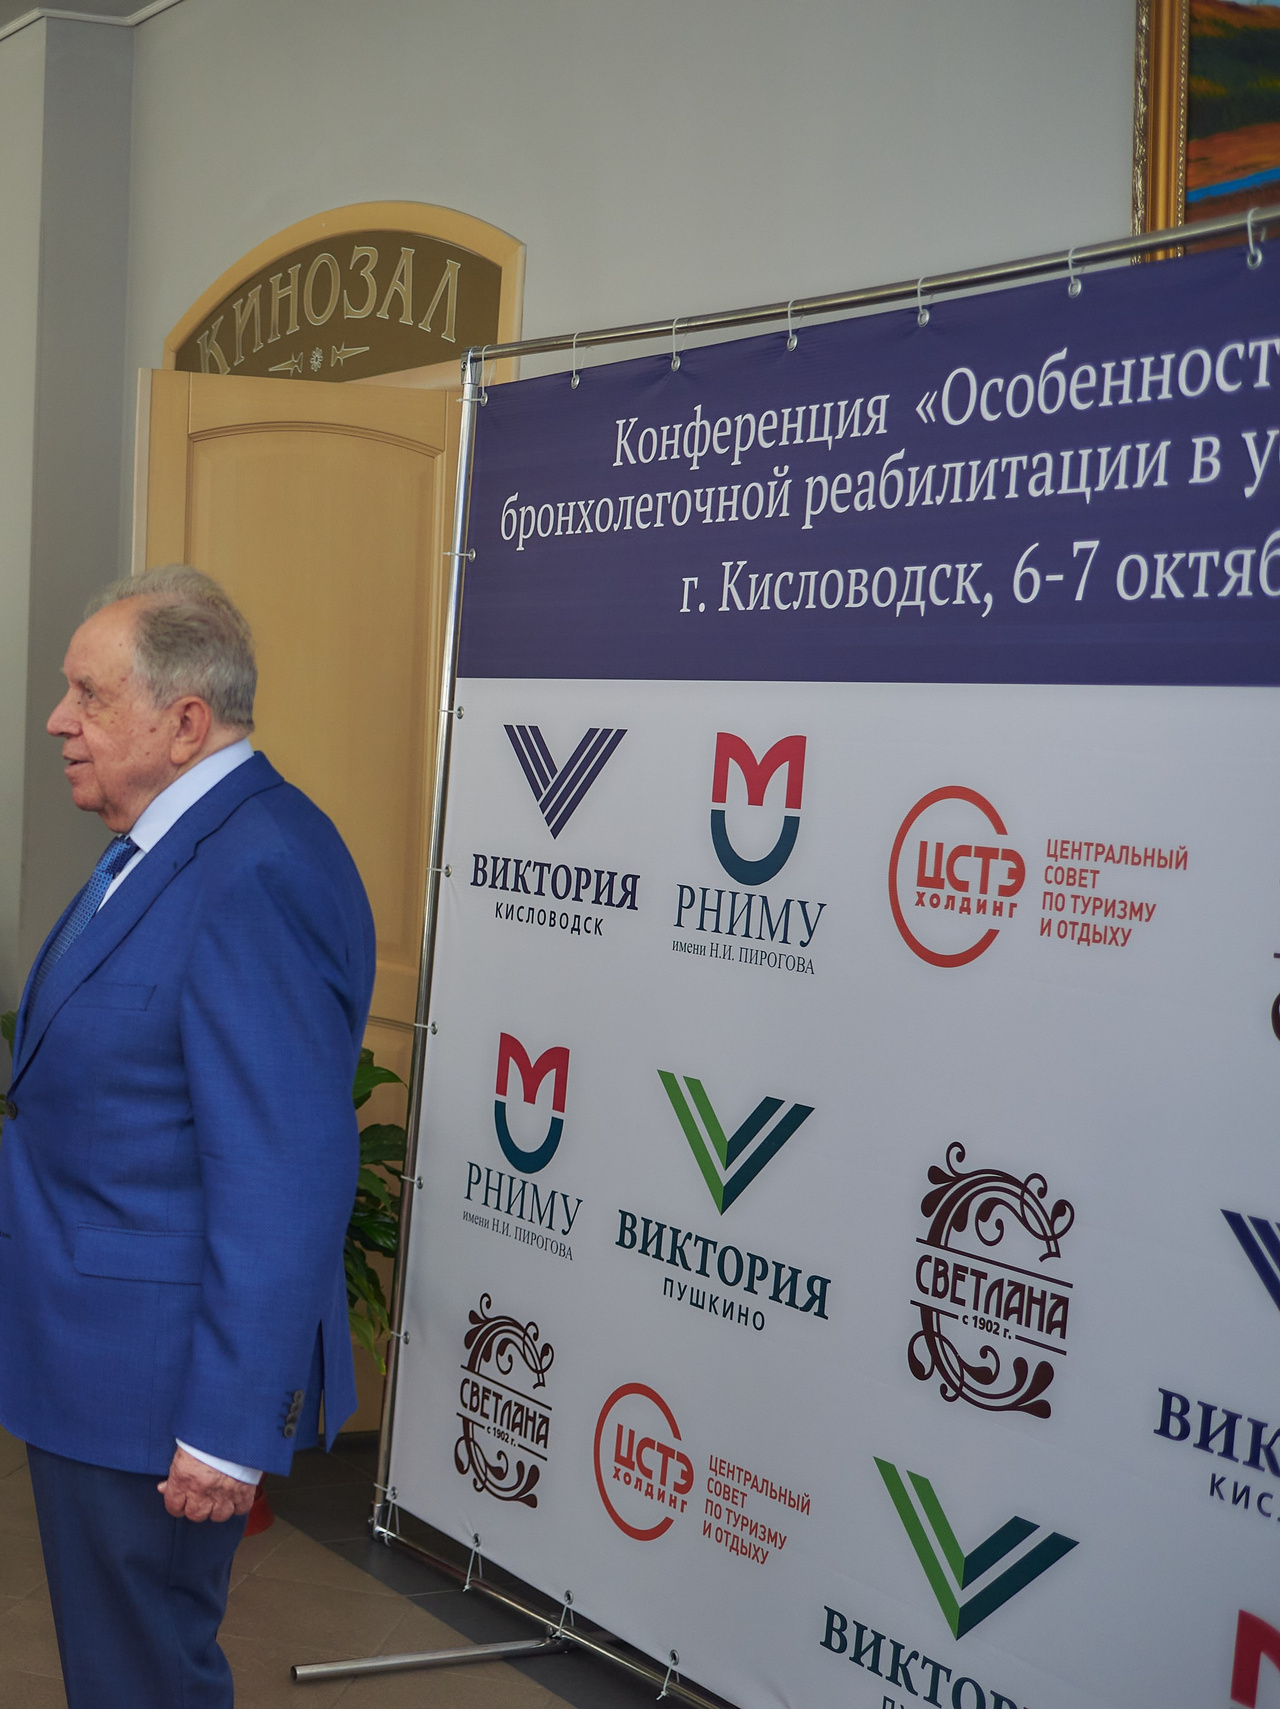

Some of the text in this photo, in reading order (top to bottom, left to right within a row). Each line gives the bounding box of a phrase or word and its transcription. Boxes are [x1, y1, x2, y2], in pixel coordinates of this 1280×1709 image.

[197, 246, 461, 374] КИНОЗАЛ
[613, 394, 890, 470] Конференция
[500, 465, 792, 551] бронхолегочной
[802, 441, 1171, 529] реабилитации
[1189, 434, 1221, 484] в
[680, 577, 706, 613] г.
[718, 561, 993, 617] Кисловодск,
[1013, 540, 1100, 603] 6-7
[916, 840, 1026, 897] ЦСТЭ
[1044, 865, 1100, 889] СОВЕТ
[1046, 838, 1188, 871] ЦЕНТРАЛЬНЫЙ
[470, 853, 640, 911] ВИКТОРИЯ
[1041, 891, 1156, 923] ПО ТУРИЗМУ
[495, 902, 604, 936] КИСЛОВОДСК
[673, 883, 827, 948] РНИМУ
[1040, 917, 1132, 947] И ОТДЫХУ
[672, 939, 815, 975] имени Н.И. ПИРОГОВА
[464, 1161, 583, 1236] РНИМУ
[462, 1210, 573, 1261] имени Н.И. ПИРОГОВА
[615, 1209, 831, 1320] ВИКТОРИЯ
[663, 1277, 765, 1331] ПУШКИНО
[916, 1254, 1069, 1339] СВЕТЛАНА
[972, 1315, 1000, 1336] 1902
[1003, 1330, 1012, 1340] г.
[460, 1378, 550, 1449] СВЕТЛАНА
[493, 1427, 509, 1443] 1902
[614, 1423, 694, 1494] ЦСТЭ
[709, 1454, 811, 1516] ЦЕНТРАЛЬНЫЙ
[707, 1477, 748, 1508] СОВЕТ
[1209, 1473, 1280, 1522] КИС
[702, 1520, 769, 1565] И ОТДЫХУ
[704, 1498, 787, 1550] ПО ТУРИЗМУ
